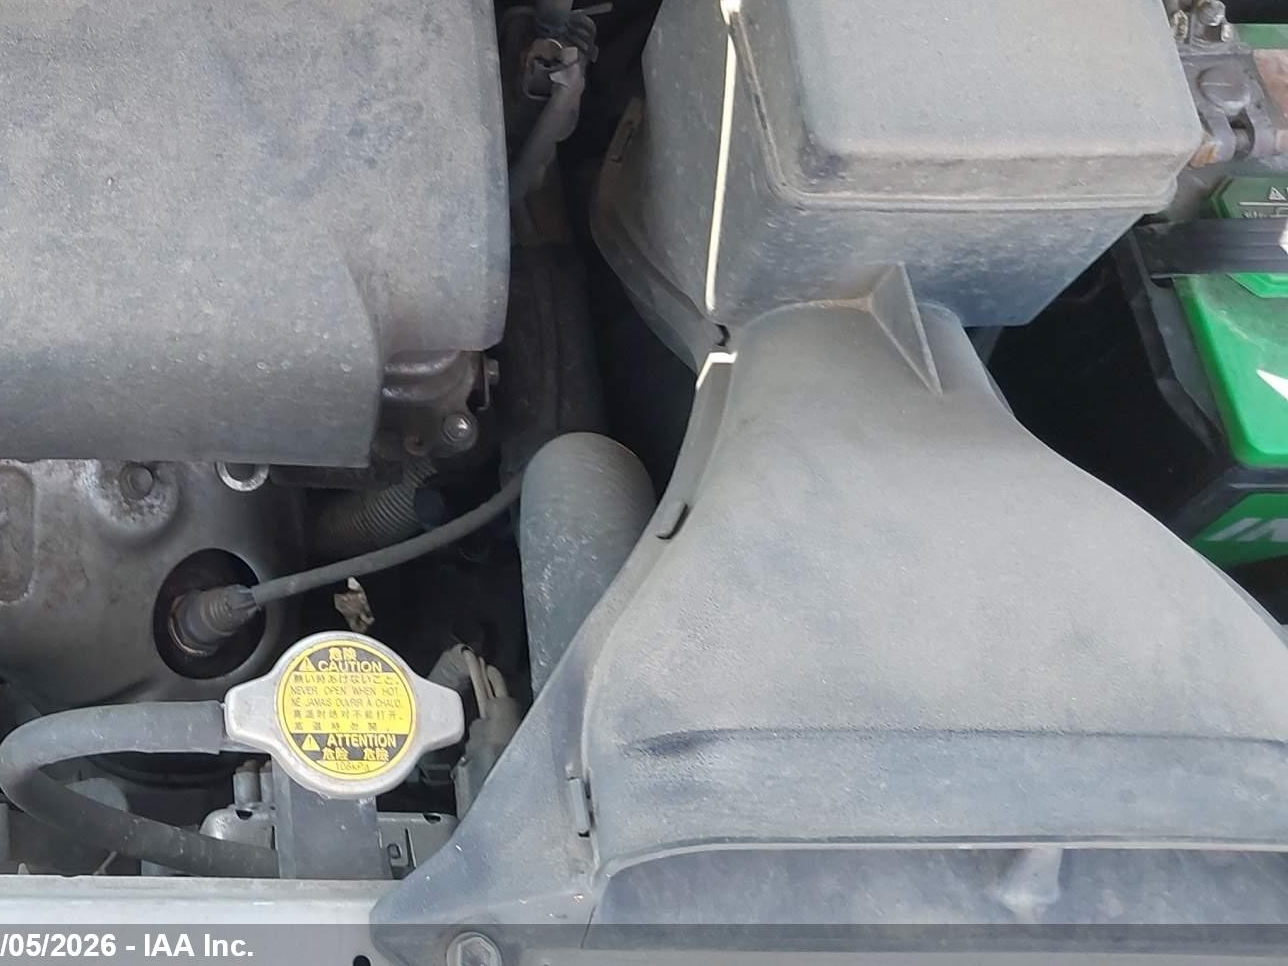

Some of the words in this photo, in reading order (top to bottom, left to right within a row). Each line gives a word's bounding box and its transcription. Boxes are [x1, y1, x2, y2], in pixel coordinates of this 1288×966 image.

[318, 660, 382, 673] CAUTION
[290, 685, 318, 695] NEVER
[324, 686, 345, 696] OPEN
[351, 686, 377, 696] WHEN
[327, 733, 397, 748] ATTENTION
